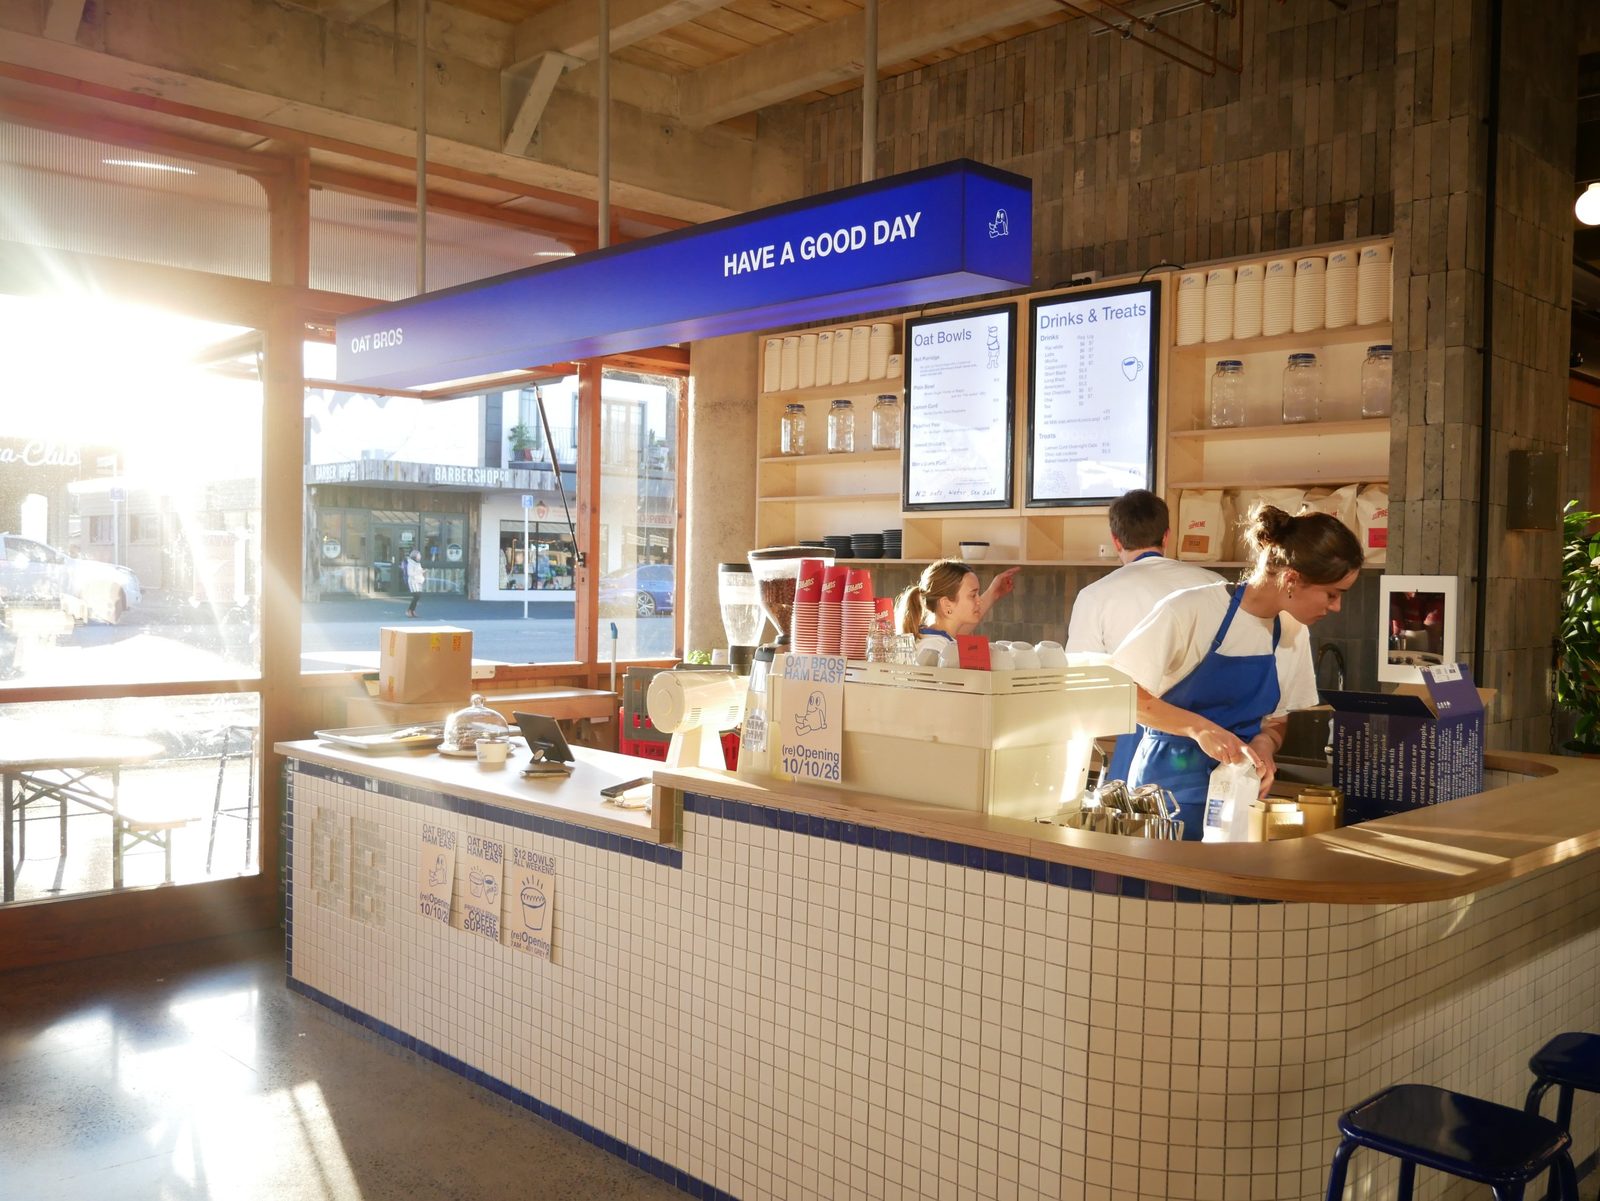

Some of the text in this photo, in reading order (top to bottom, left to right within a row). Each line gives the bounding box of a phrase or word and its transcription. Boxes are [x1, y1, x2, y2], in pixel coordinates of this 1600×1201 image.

[724, 212, 922, 277] HAVE A GOOD DAY
[1040, 303, 1147, 329] Drinks & Treats
[351, 328, 403, 354] OAT BROS
[914, 328, 972, 347] Oat Bowls
[316, 465, 336, 481] BARBER
[785, 655, 845, 672] OAT BROS
[784, 668, 844, 684] HAM EAST
[782, 744, 840, 767] (re)Opening
[782, 758, 840, 781] 10/10/26
[422, 823, 456, 841] OAT BROS
[422, 832, 456, 852] HAM EAST
[466, 835, 503, 856] OAT BROS
[466, 847, 502, 865] HAM EAST
[513, 847, 555, 868] $12 BOWLS
[513, 858, 554, 876] ALL WEEKEND
[468, 909, 497, 929] COFFEE
[464, 918, 499, 942] SUPREME
